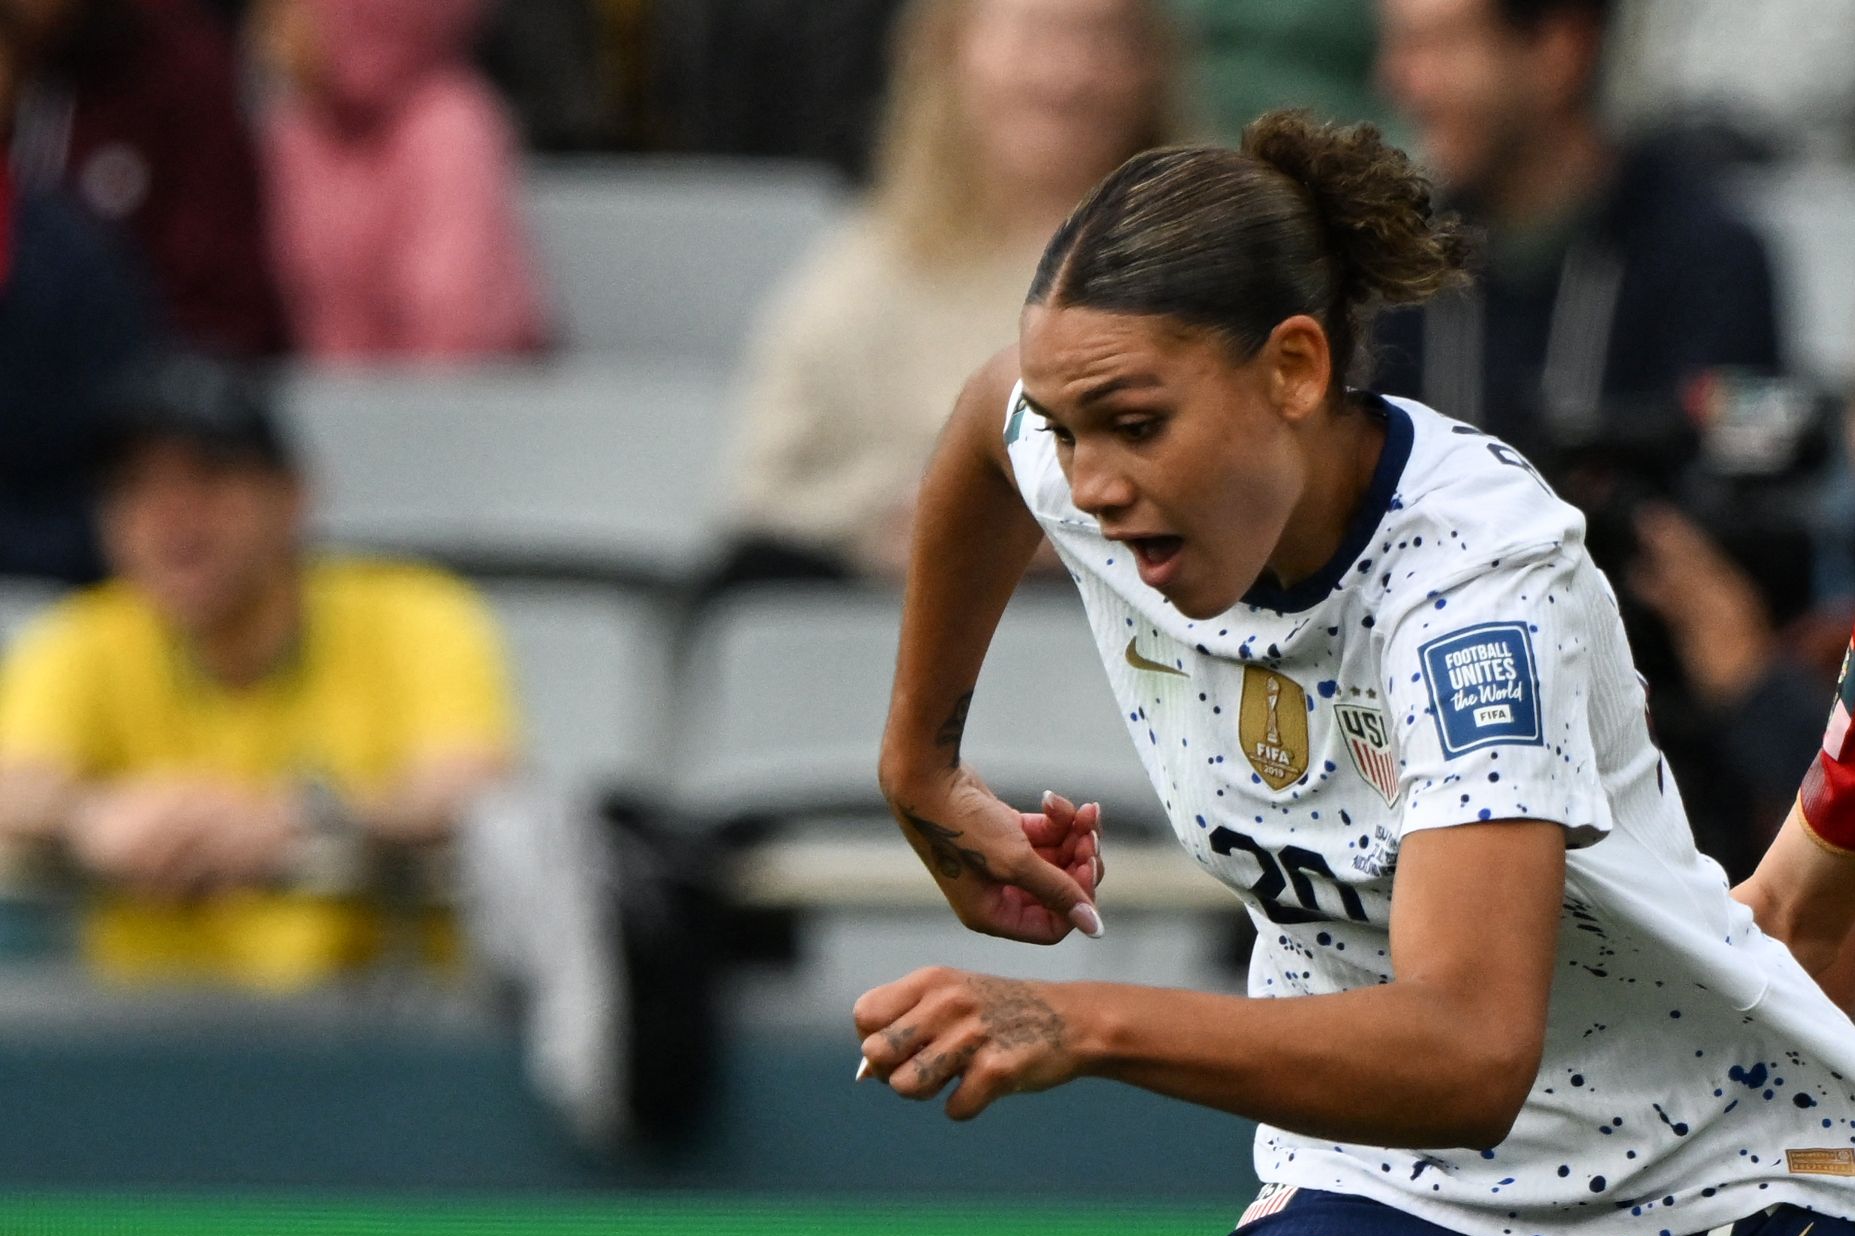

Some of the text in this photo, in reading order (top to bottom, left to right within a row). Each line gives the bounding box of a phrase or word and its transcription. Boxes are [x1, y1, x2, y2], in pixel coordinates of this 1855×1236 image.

[1446, 642, 1512, 669] FOOTBALL
[1449, 658, 1516, 689] UNITES
[1450, 681, 1521, 712] the World
[1480, 709, 1506, 722] FIFA
[1257, 743, 1289, 765] FIFA
[1264, 766, 1284, 777] 2019
[1209, 825, 1370, 924] 20
